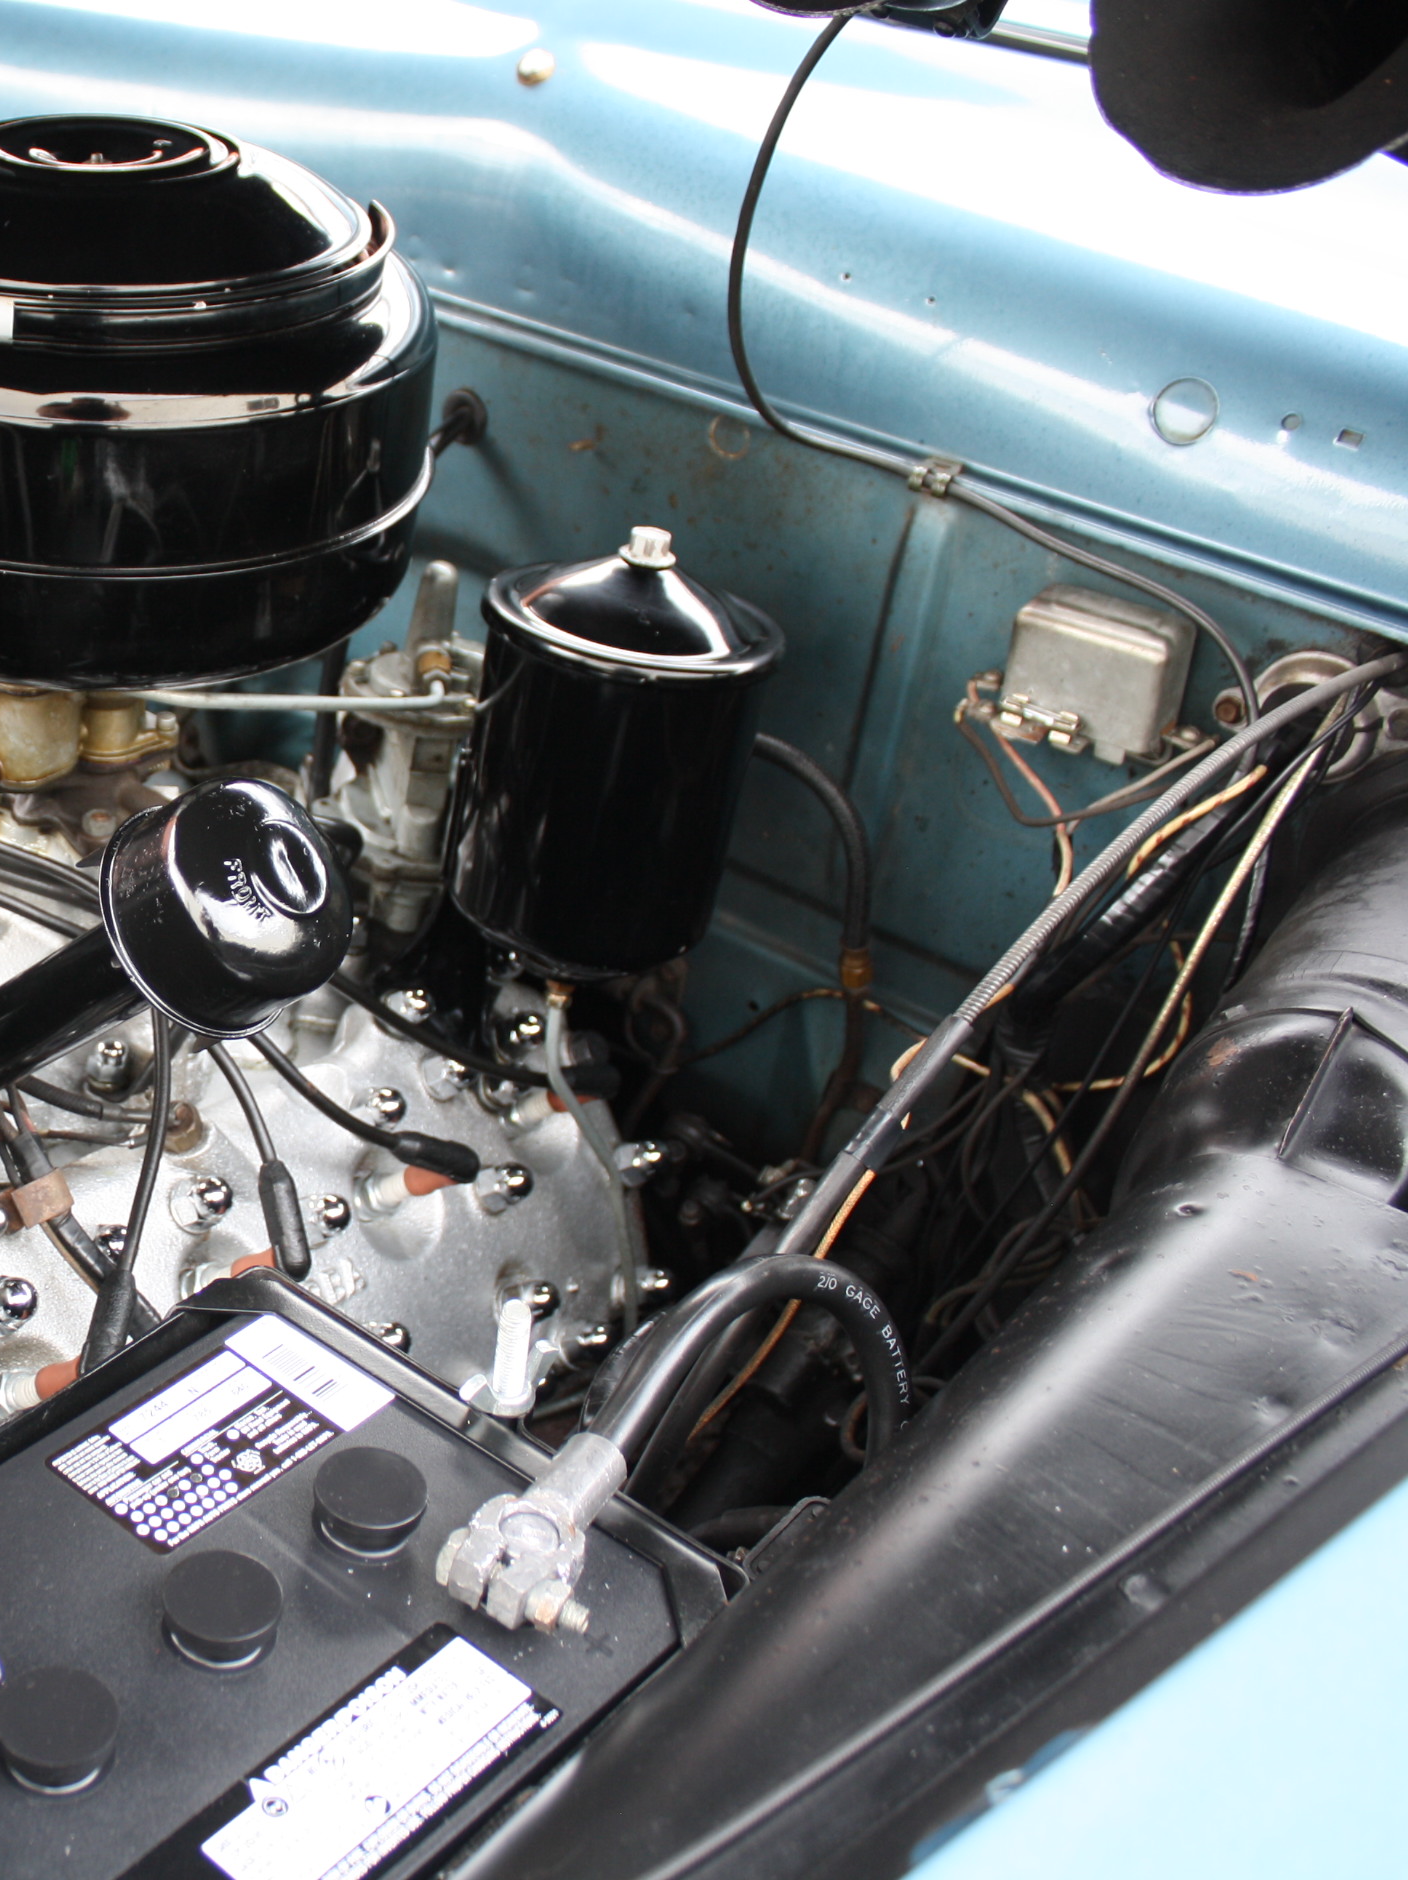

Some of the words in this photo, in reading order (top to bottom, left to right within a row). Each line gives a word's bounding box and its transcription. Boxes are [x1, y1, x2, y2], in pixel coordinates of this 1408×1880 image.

[223, 858, 274, 922] FRONT
[817, 1275, 838, 1290] 2/0
[845, 1284, 881, 1319] GAGE
[881, 1324, 910, 1405] BATTERY
